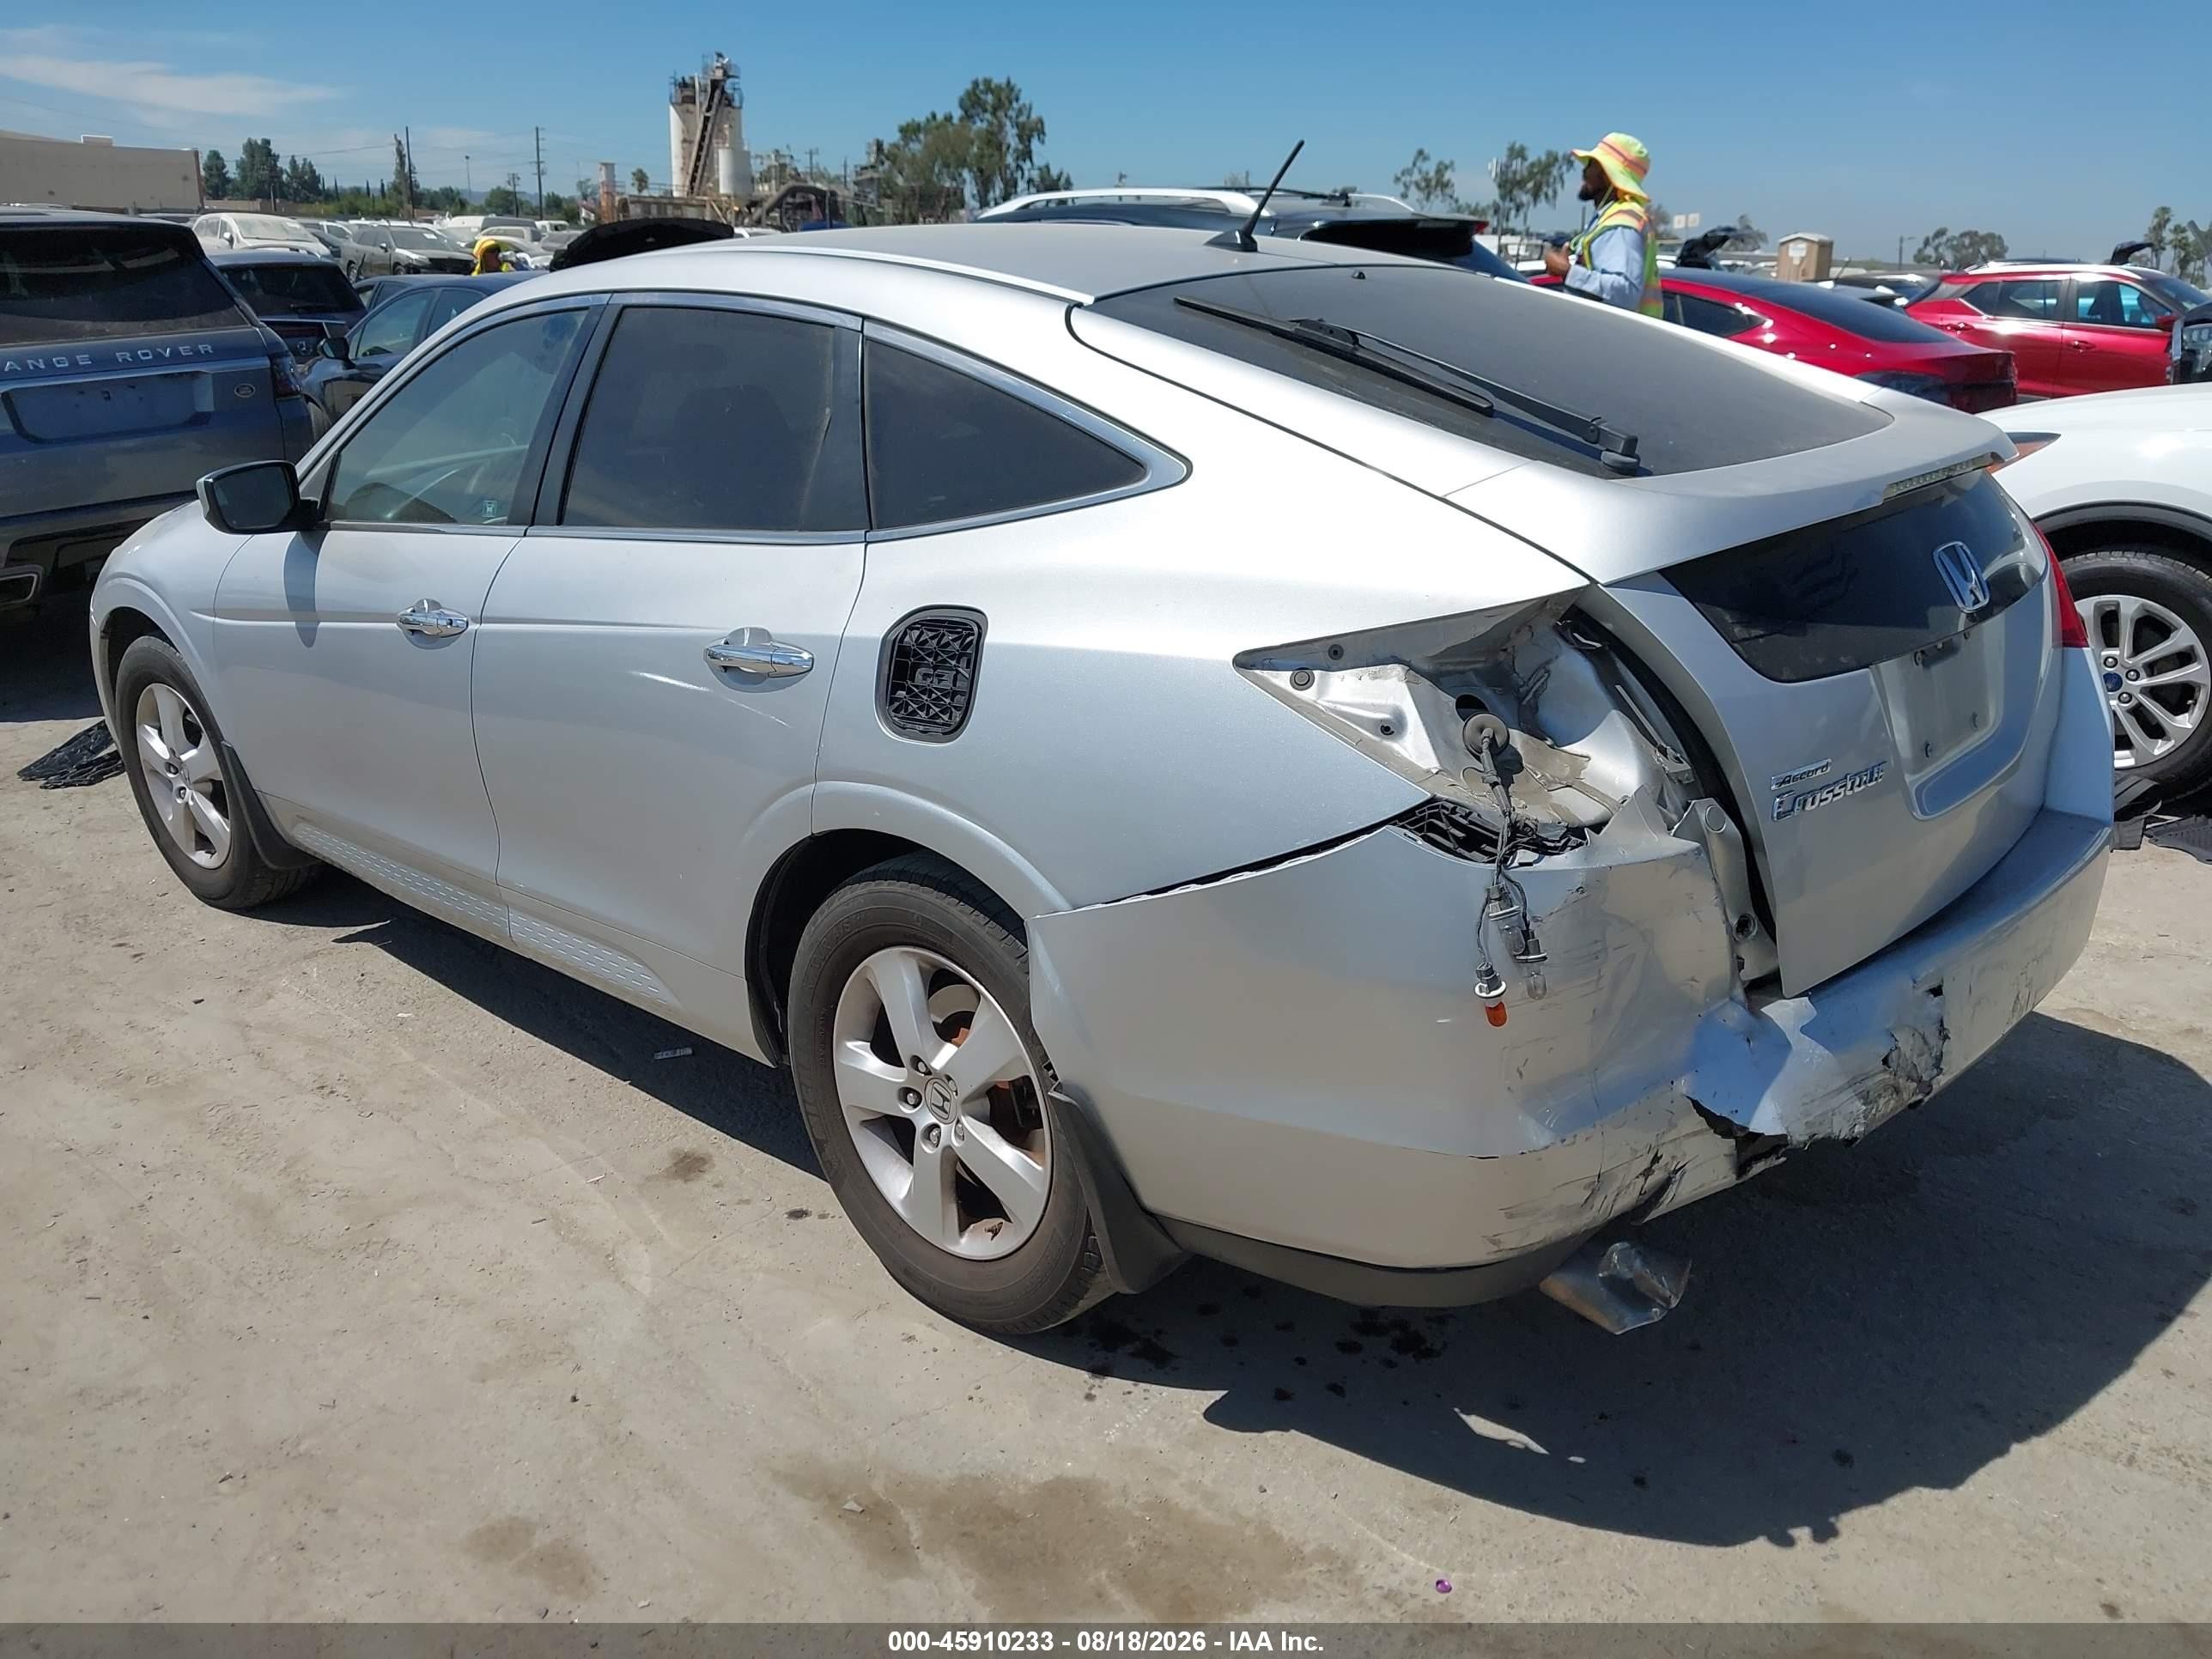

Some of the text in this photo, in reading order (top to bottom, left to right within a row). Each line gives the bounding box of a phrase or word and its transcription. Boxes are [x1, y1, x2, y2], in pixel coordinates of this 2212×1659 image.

[3, 343, 214, 372] ANGE ROVER
[1774, 761, 1830, 788] Accord
